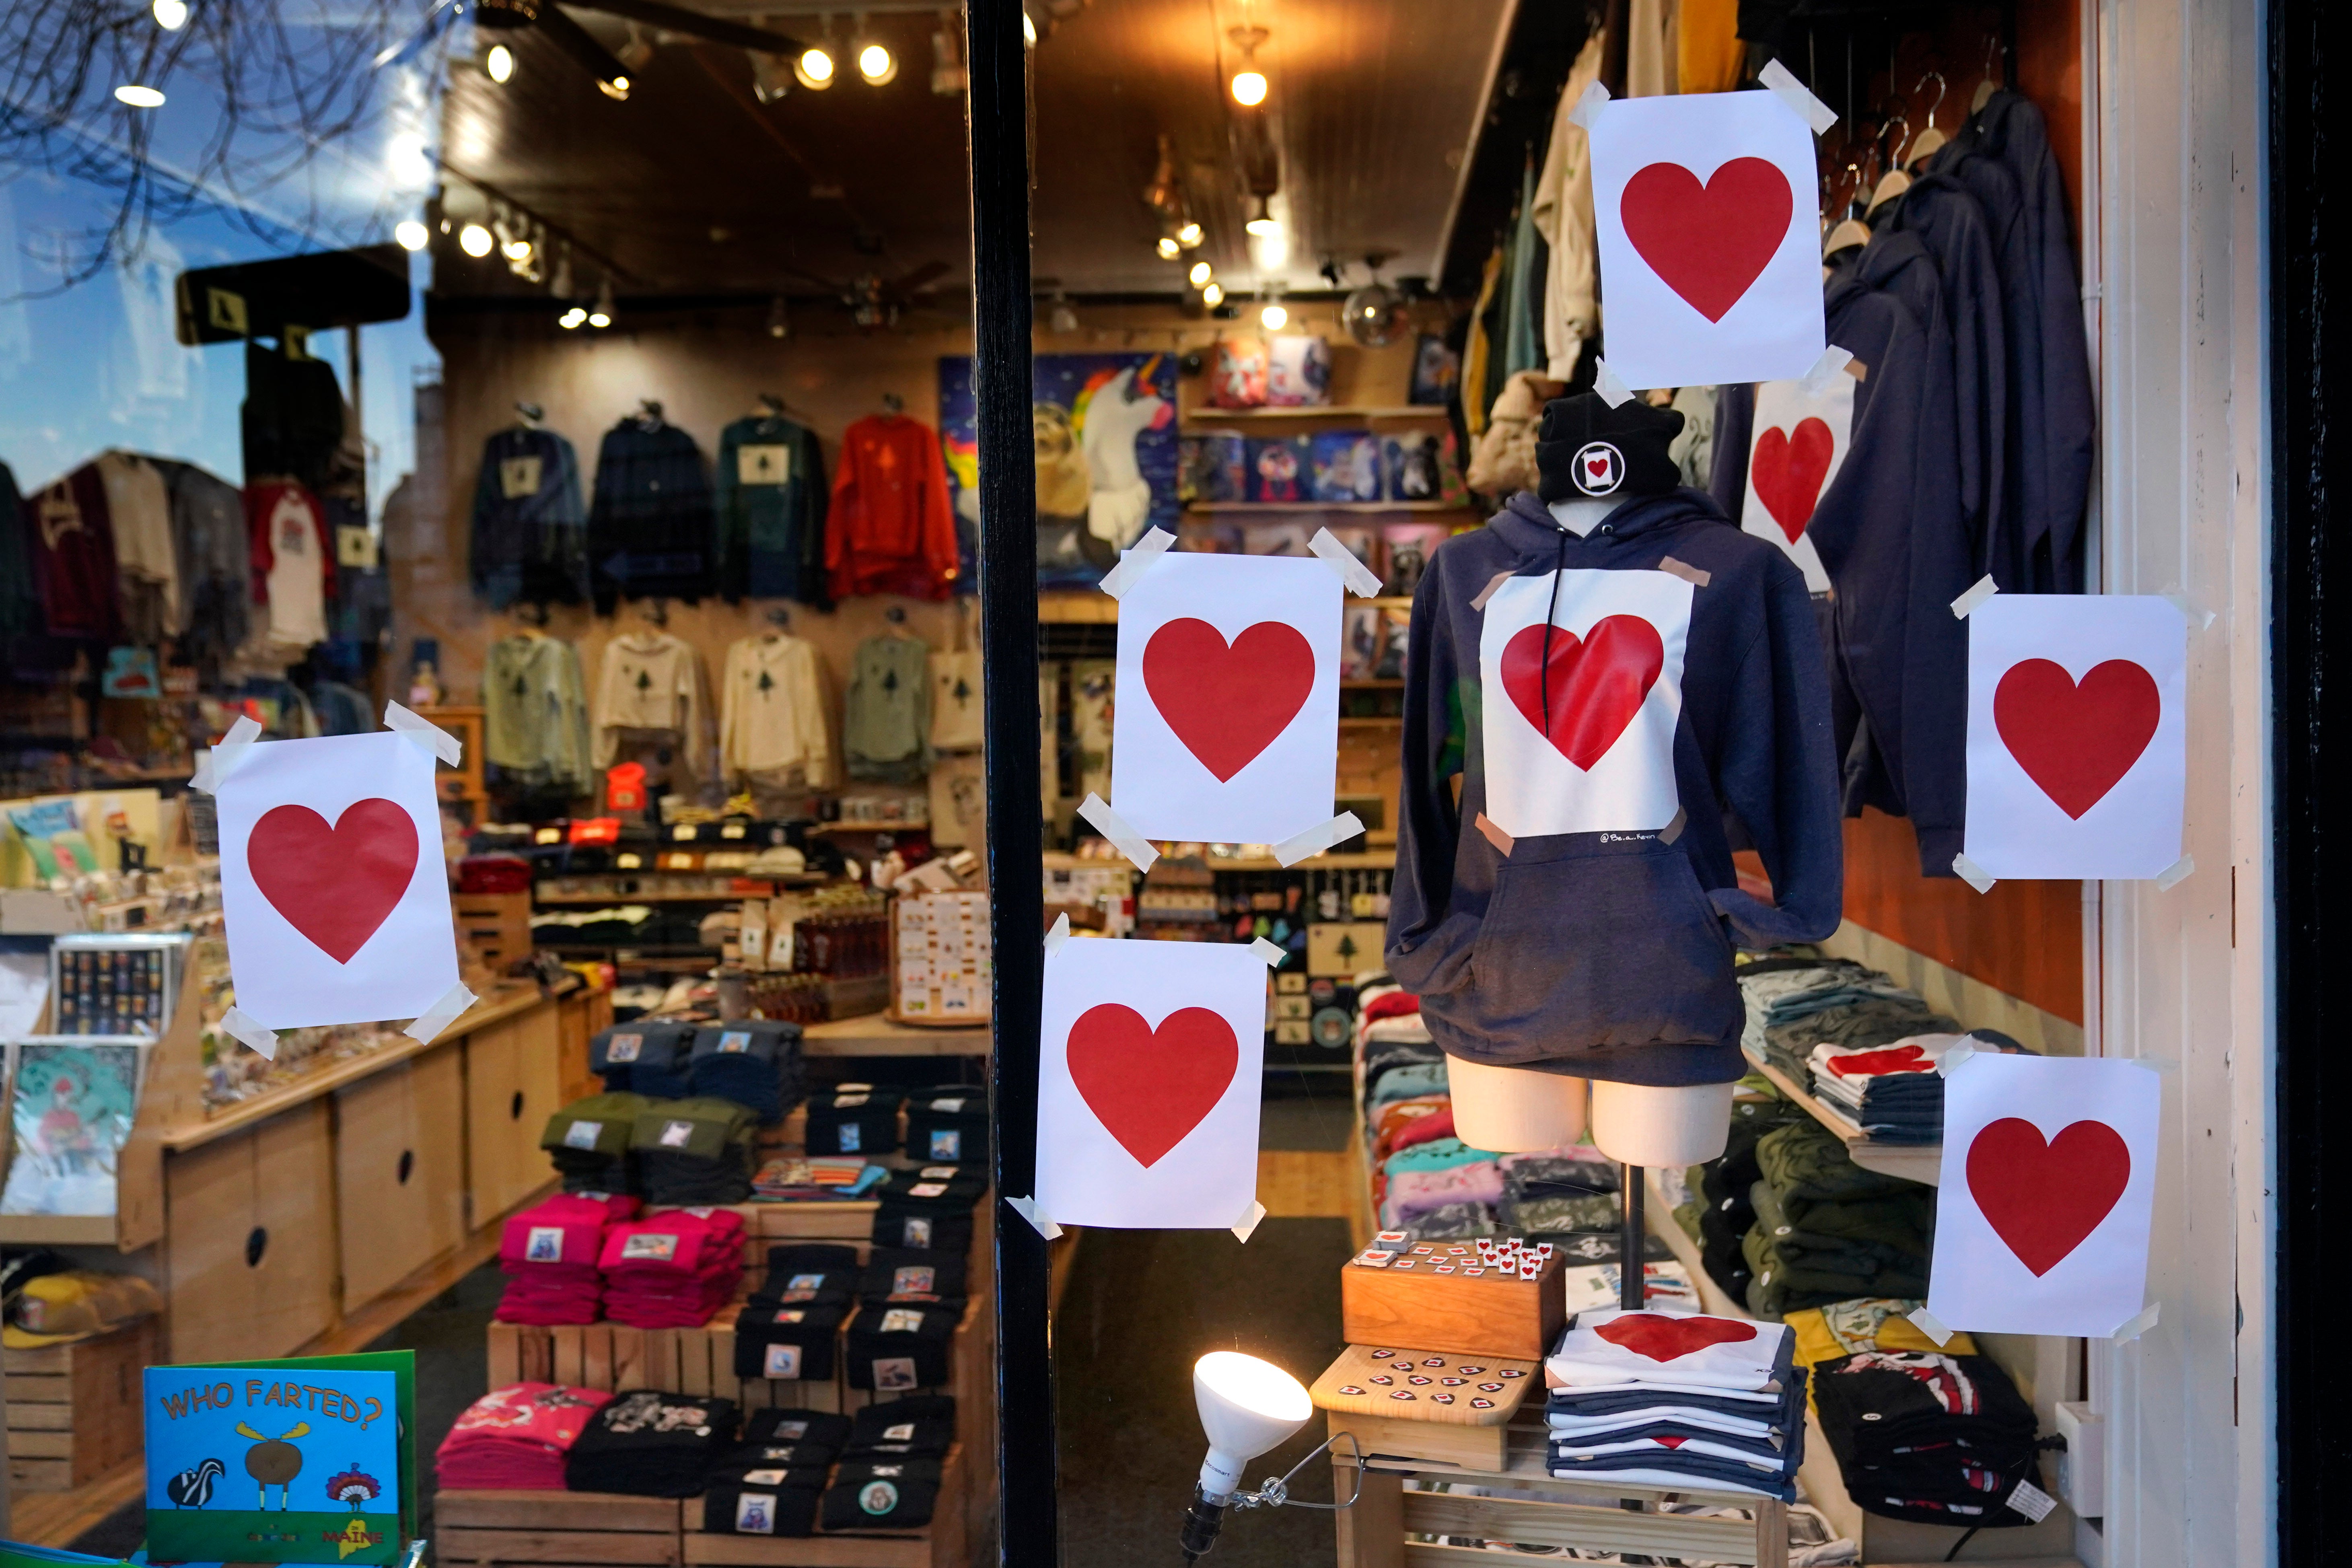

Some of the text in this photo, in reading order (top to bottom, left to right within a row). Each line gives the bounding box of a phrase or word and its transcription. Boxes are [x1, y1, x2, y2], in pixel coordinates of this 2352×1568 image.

[161, 1379, 383, 1431] WHO FARTED?
[323, 1531, 384, 1544] MAINE
